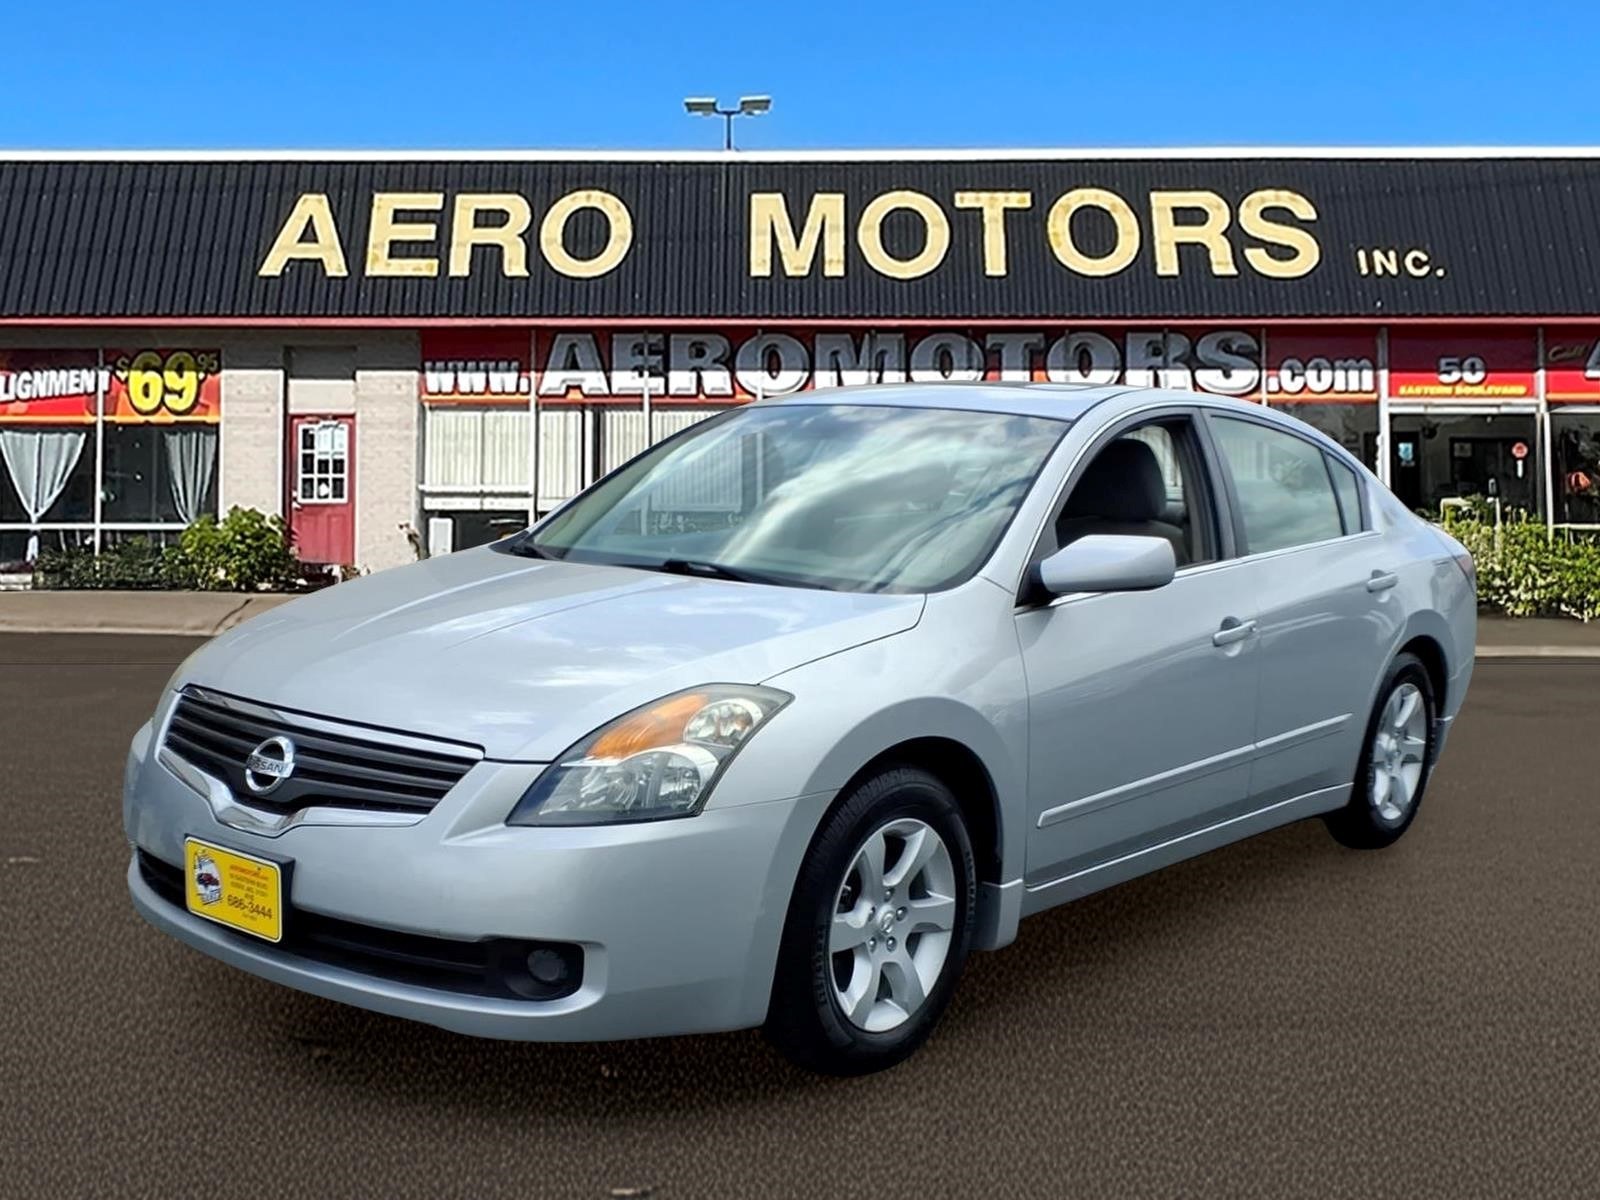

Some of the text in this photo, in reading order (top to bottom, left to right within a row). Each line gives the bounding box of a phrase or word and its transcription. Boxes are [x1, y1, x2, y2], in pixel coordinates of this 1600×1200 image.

[257, 187, 1446, 280] AERO MOTORS INC.
[1437, 356, 1487, 384] 50
[1399, 384, 1527, 396] EASTERN BOULEVARD
